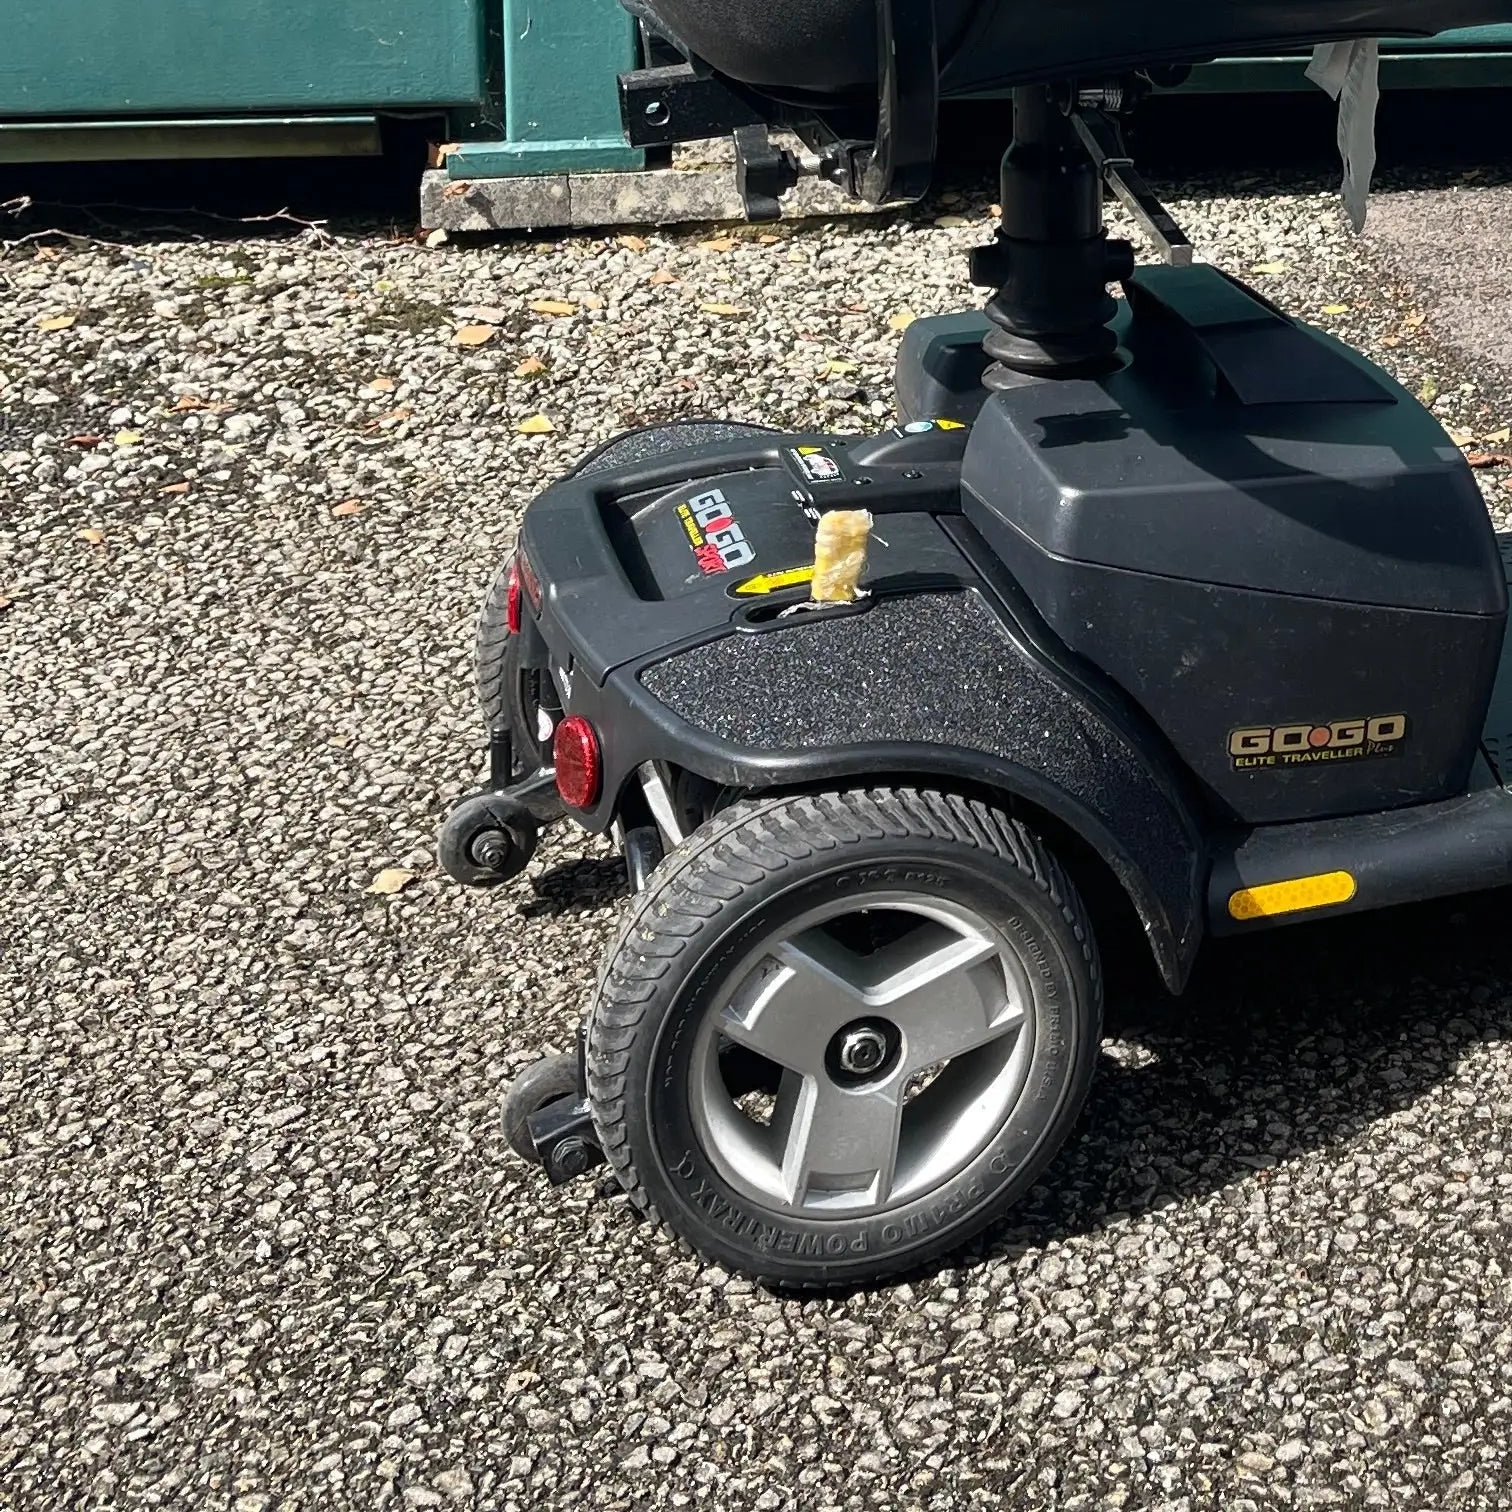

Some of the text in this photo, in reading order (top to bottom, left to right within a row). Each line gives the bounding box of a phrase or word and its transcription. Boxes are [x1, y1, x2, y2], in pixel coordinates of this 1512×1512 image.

[1235, 755, 1276, 768] ELITE
[1282, 747, 1363, 764] TRAVELLER
[1007, 915, 1053, 980] DESIGNED
[690, 1179, 870, 1257] POWERTRAX
